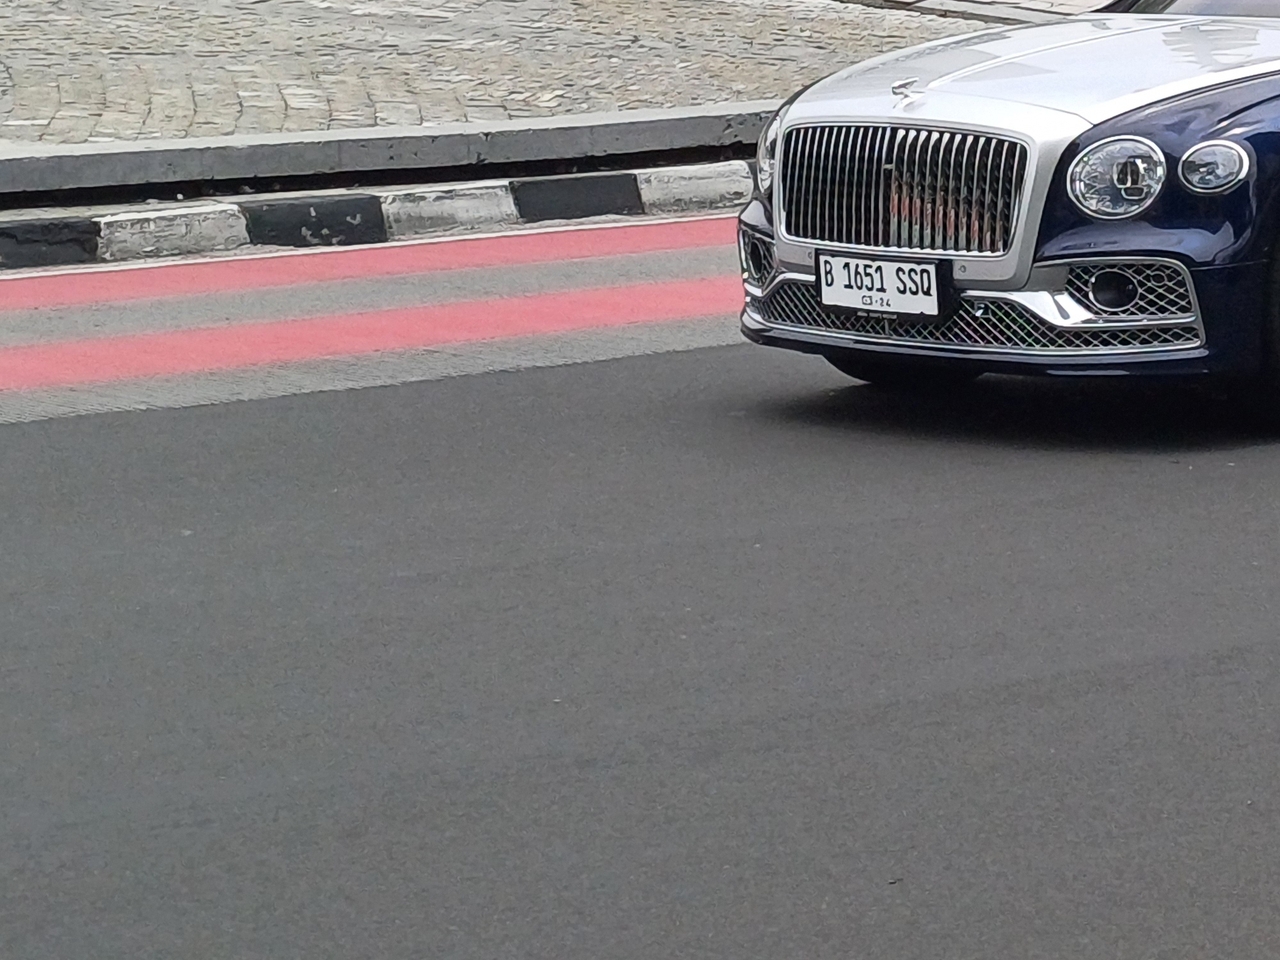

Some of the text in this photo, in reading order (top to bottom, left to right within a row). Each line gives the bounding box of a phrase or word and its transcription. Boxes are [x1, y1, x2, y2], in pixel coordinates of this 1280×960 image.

[824, 259, 933, 296] B 1651 SSQ
